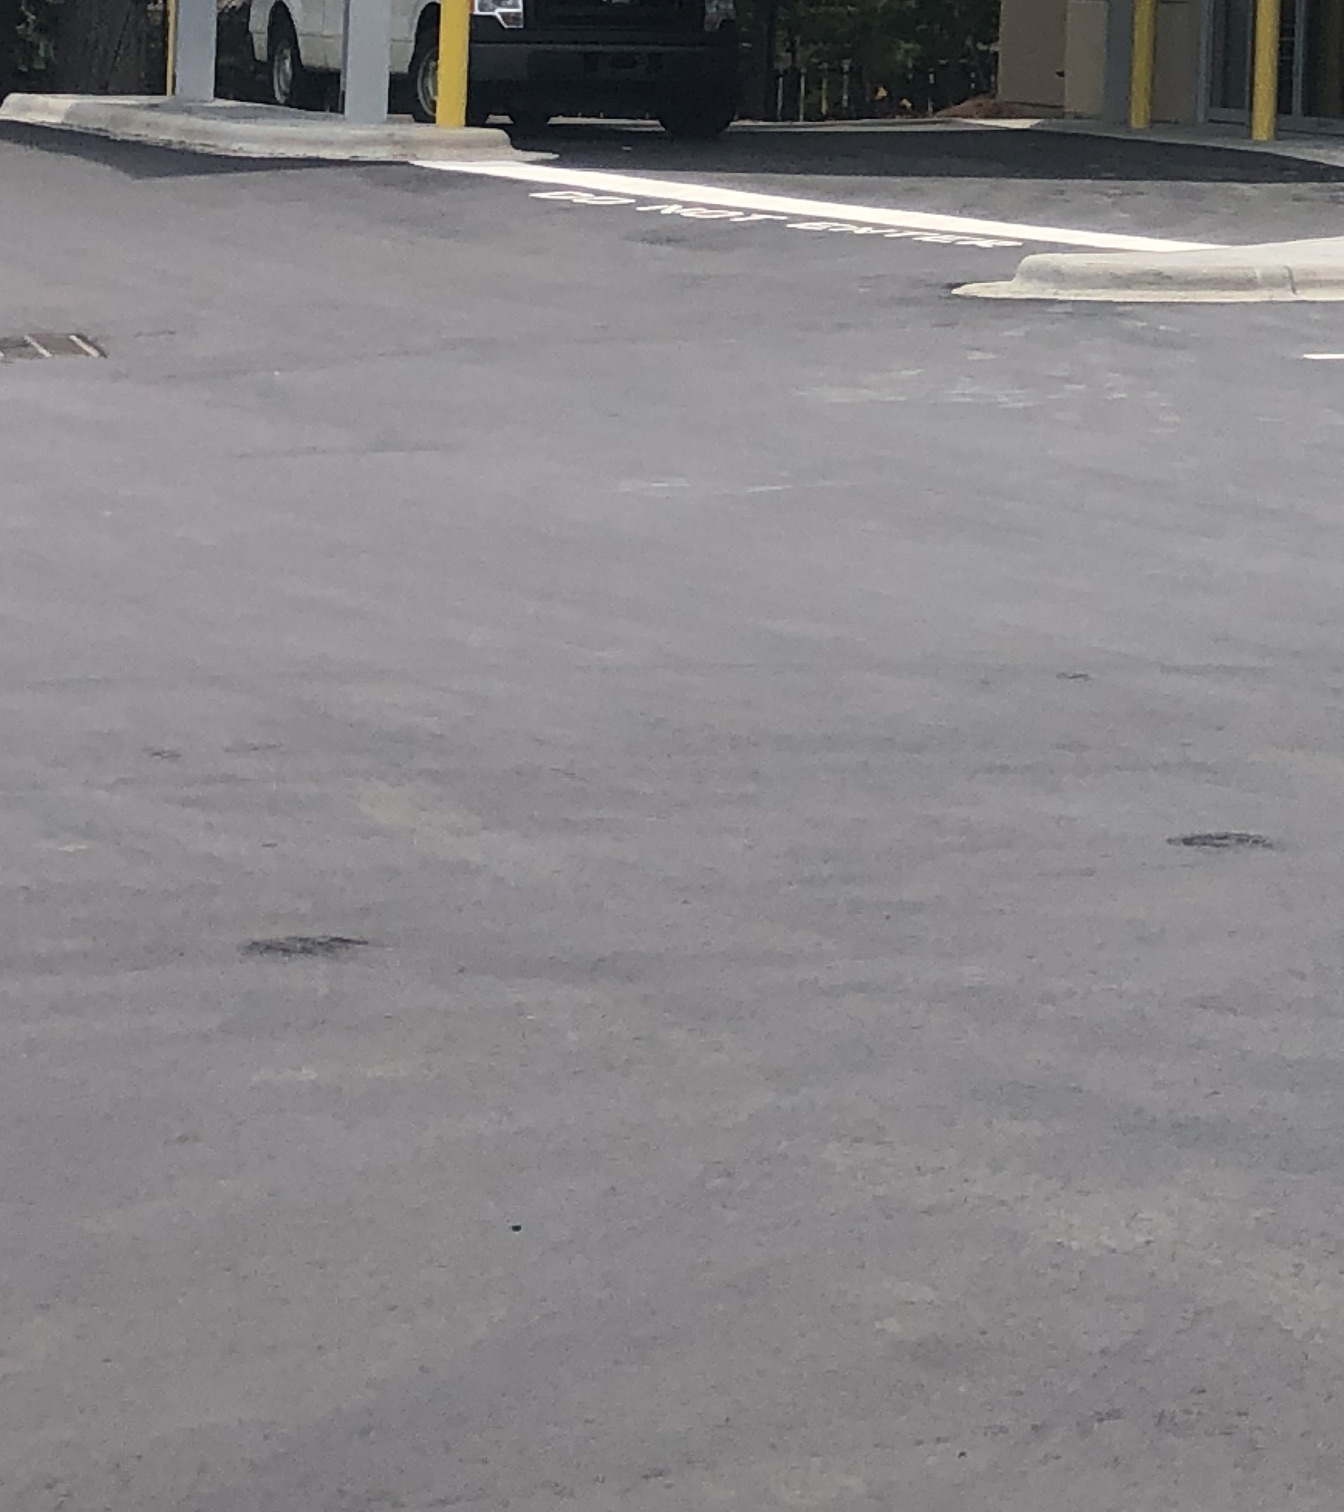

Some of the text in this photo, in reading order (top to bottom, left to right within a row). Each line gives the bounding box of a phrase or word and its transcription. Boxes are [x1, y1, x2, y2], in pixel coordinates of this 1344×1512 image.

[528, 190, 1024, 248] DO NOT ENTER
